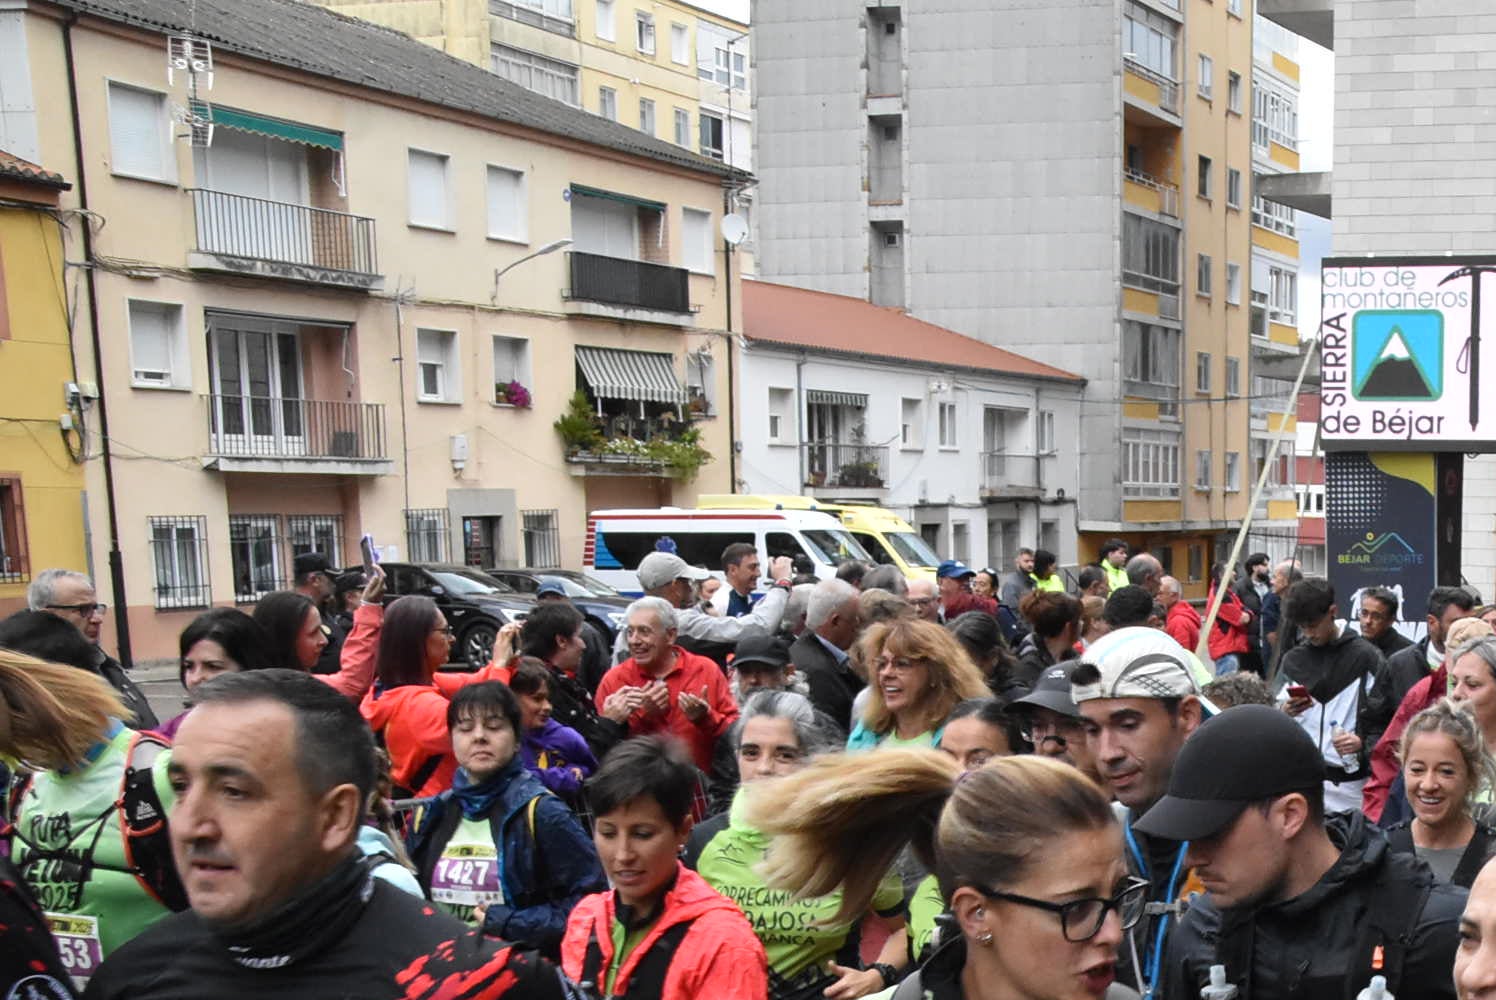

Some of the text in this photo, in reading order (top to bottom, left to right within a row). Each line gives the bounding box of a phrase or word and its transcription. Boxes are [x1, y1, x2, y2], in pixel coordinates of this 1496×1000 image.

[1323, 266, 1416, 287] club de
[1323, 287, 1468, 308] montañeros
[1323, 312, 1347, 407] SIERRA
[1323, 408, 1445, 440] de Béjar
[437, 860, 490, 886] 1427
[745, 911, 819, 932] BAJOSA
